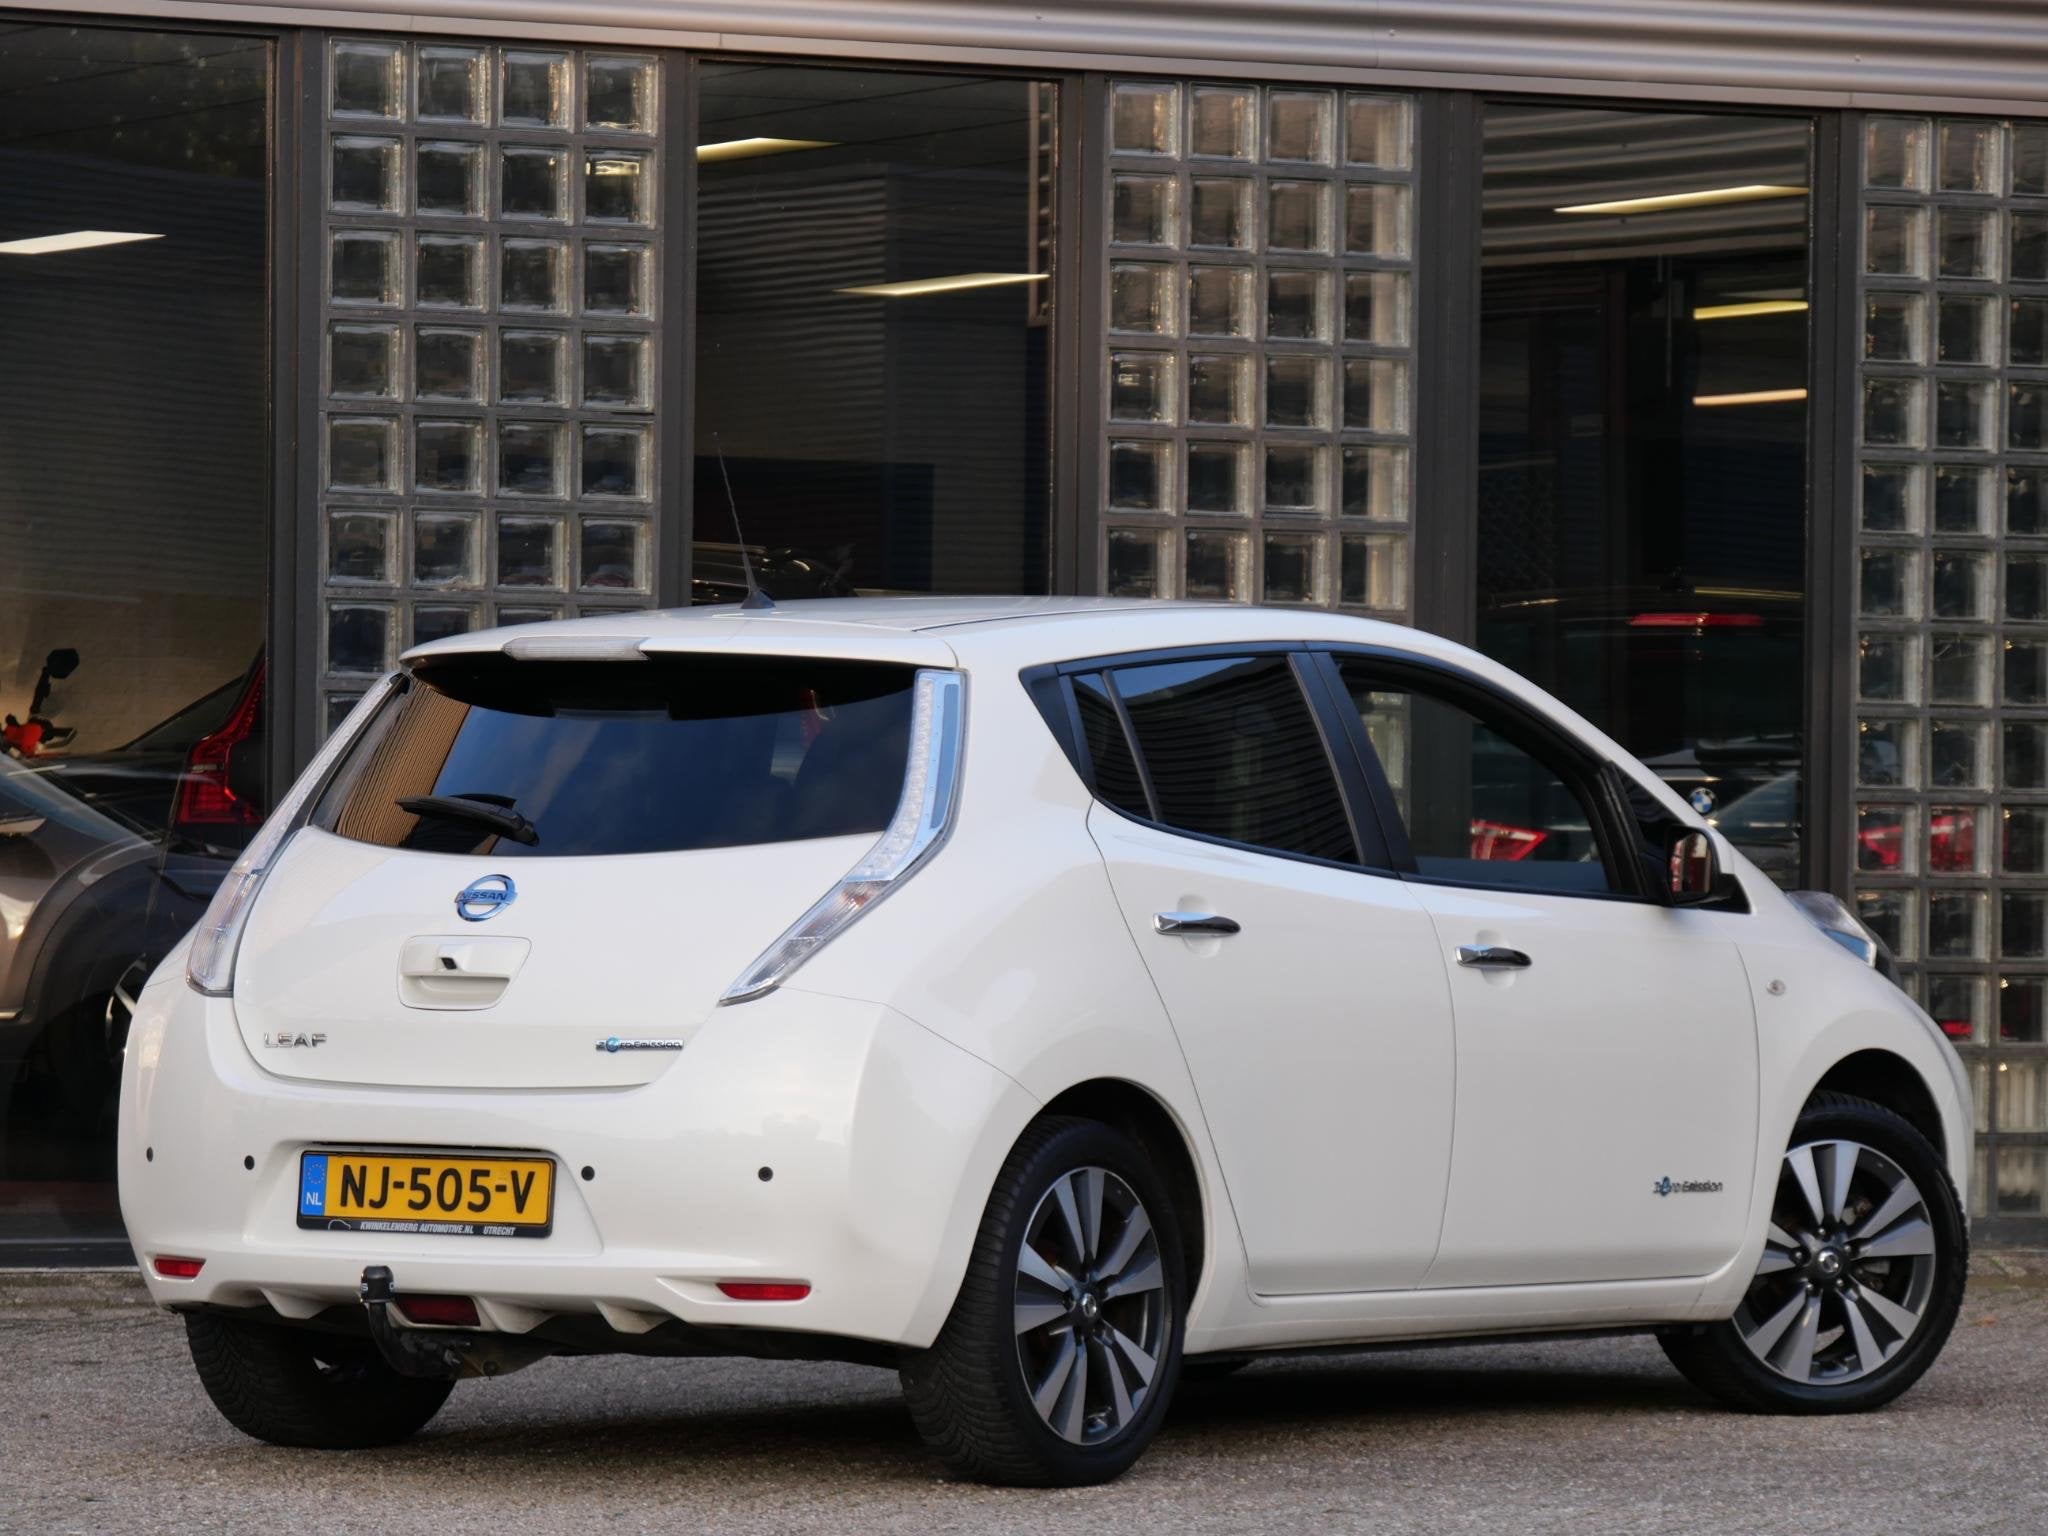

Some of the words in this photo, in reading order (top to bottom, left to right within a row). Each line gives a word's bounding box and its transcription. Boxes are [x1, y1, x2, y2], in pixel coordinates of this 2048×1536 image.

[460, 890, 508, 901] NISSAN
[264, 1032, 328, 1048] LEAF
[340, 1164, 536, 1214] NJ-505-V
[306, 1191, 322, 1206] NL
[360, 1221, 419, 1232] KWINKELENBERG
[483, 1226, 516, 1236] UTRECHT
